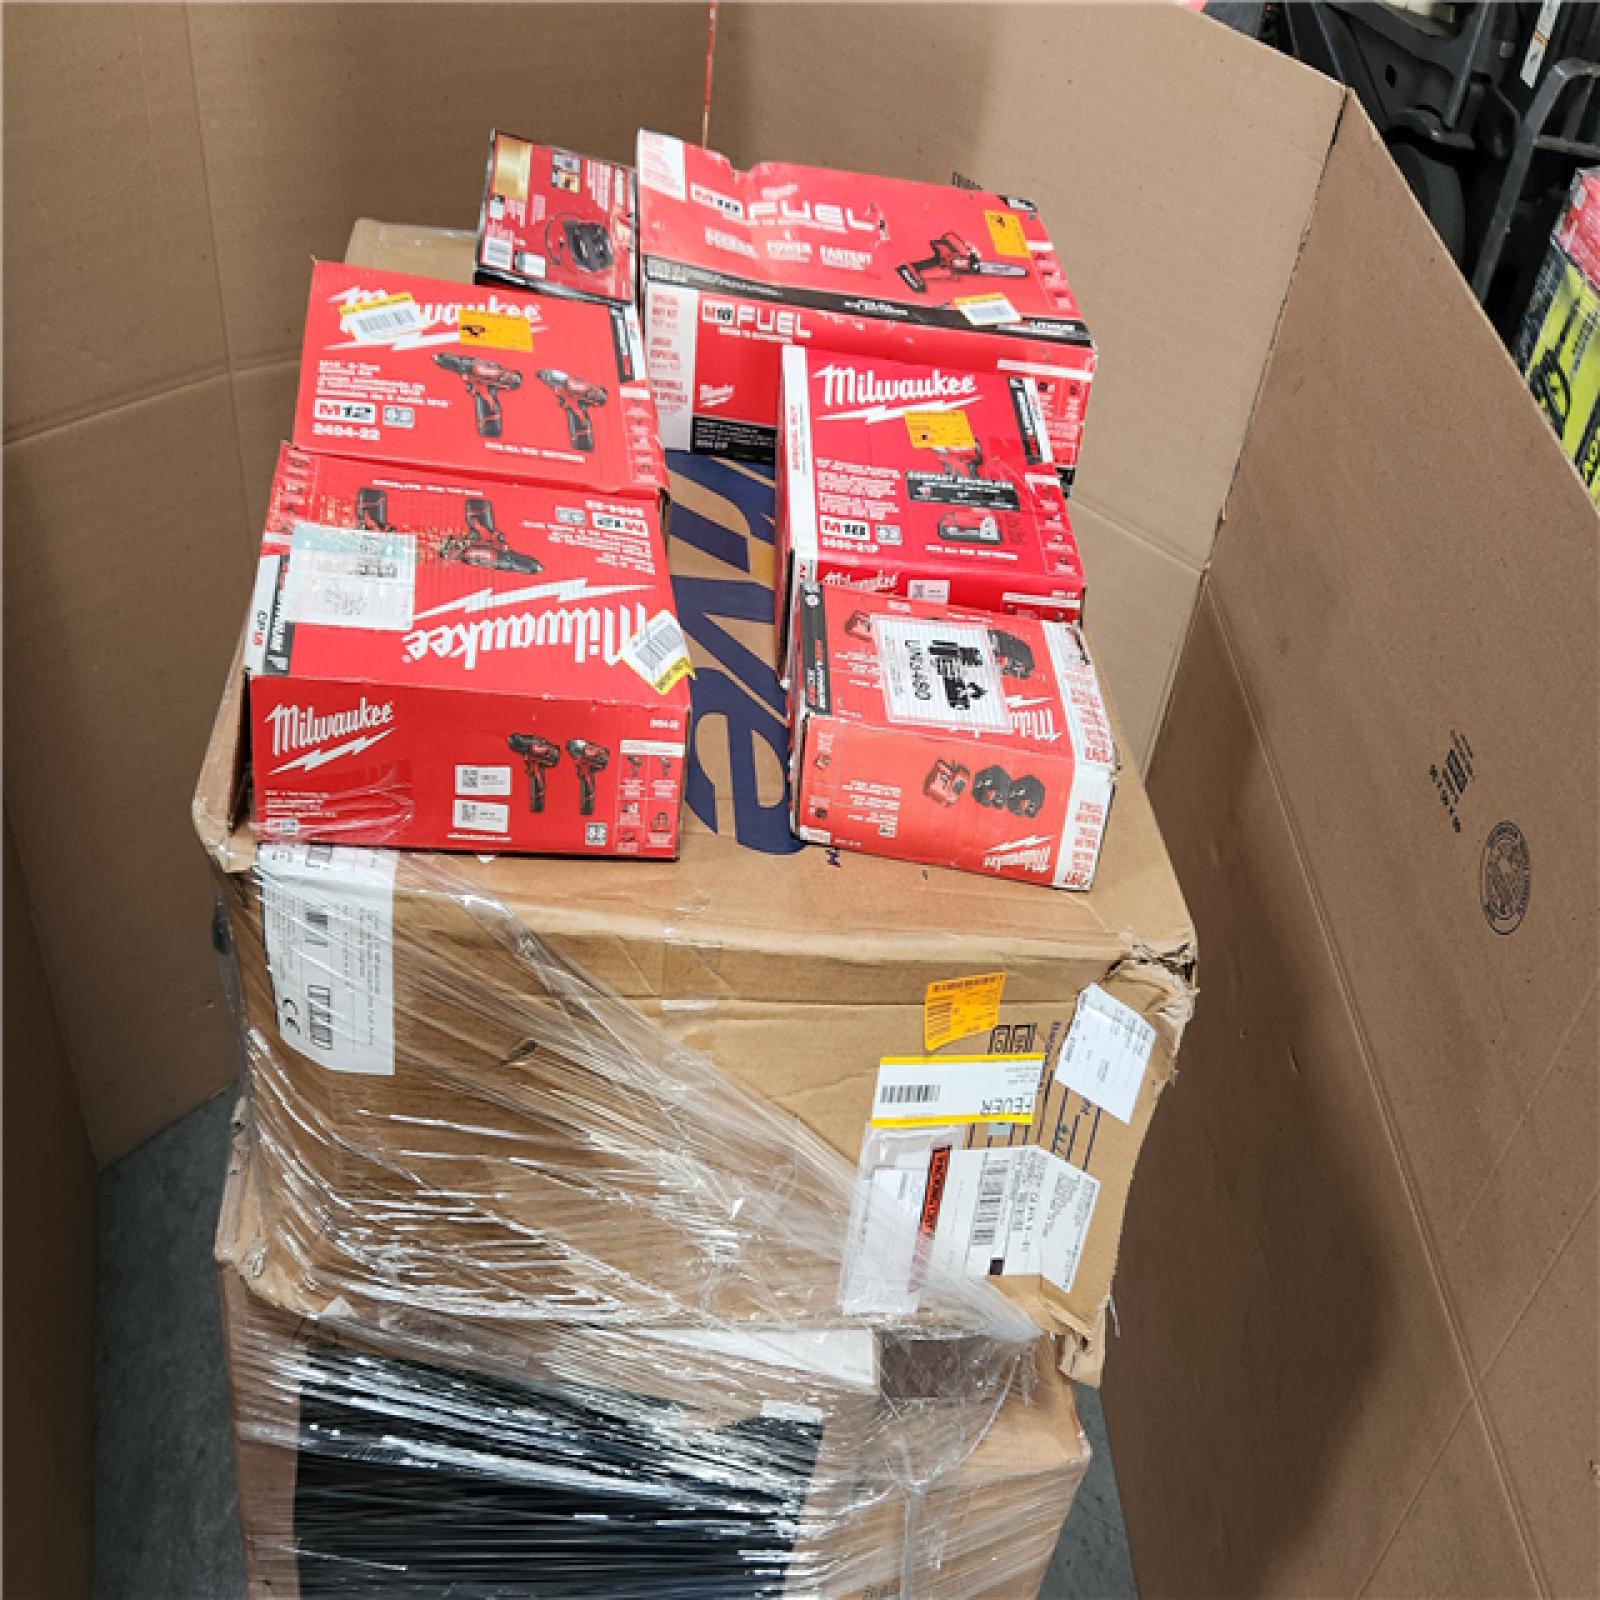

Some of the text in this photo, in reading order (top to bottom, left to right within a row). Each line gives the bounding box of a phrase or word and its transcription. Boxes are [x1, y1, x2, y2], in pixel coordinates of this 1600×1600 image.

[747, 199, 876, 232] FUEL
[737, 304, 812, 338] FUEL
[812, 364, 978, 406] Milwaukee
[264, 697, 394, 756] Milwaukee
